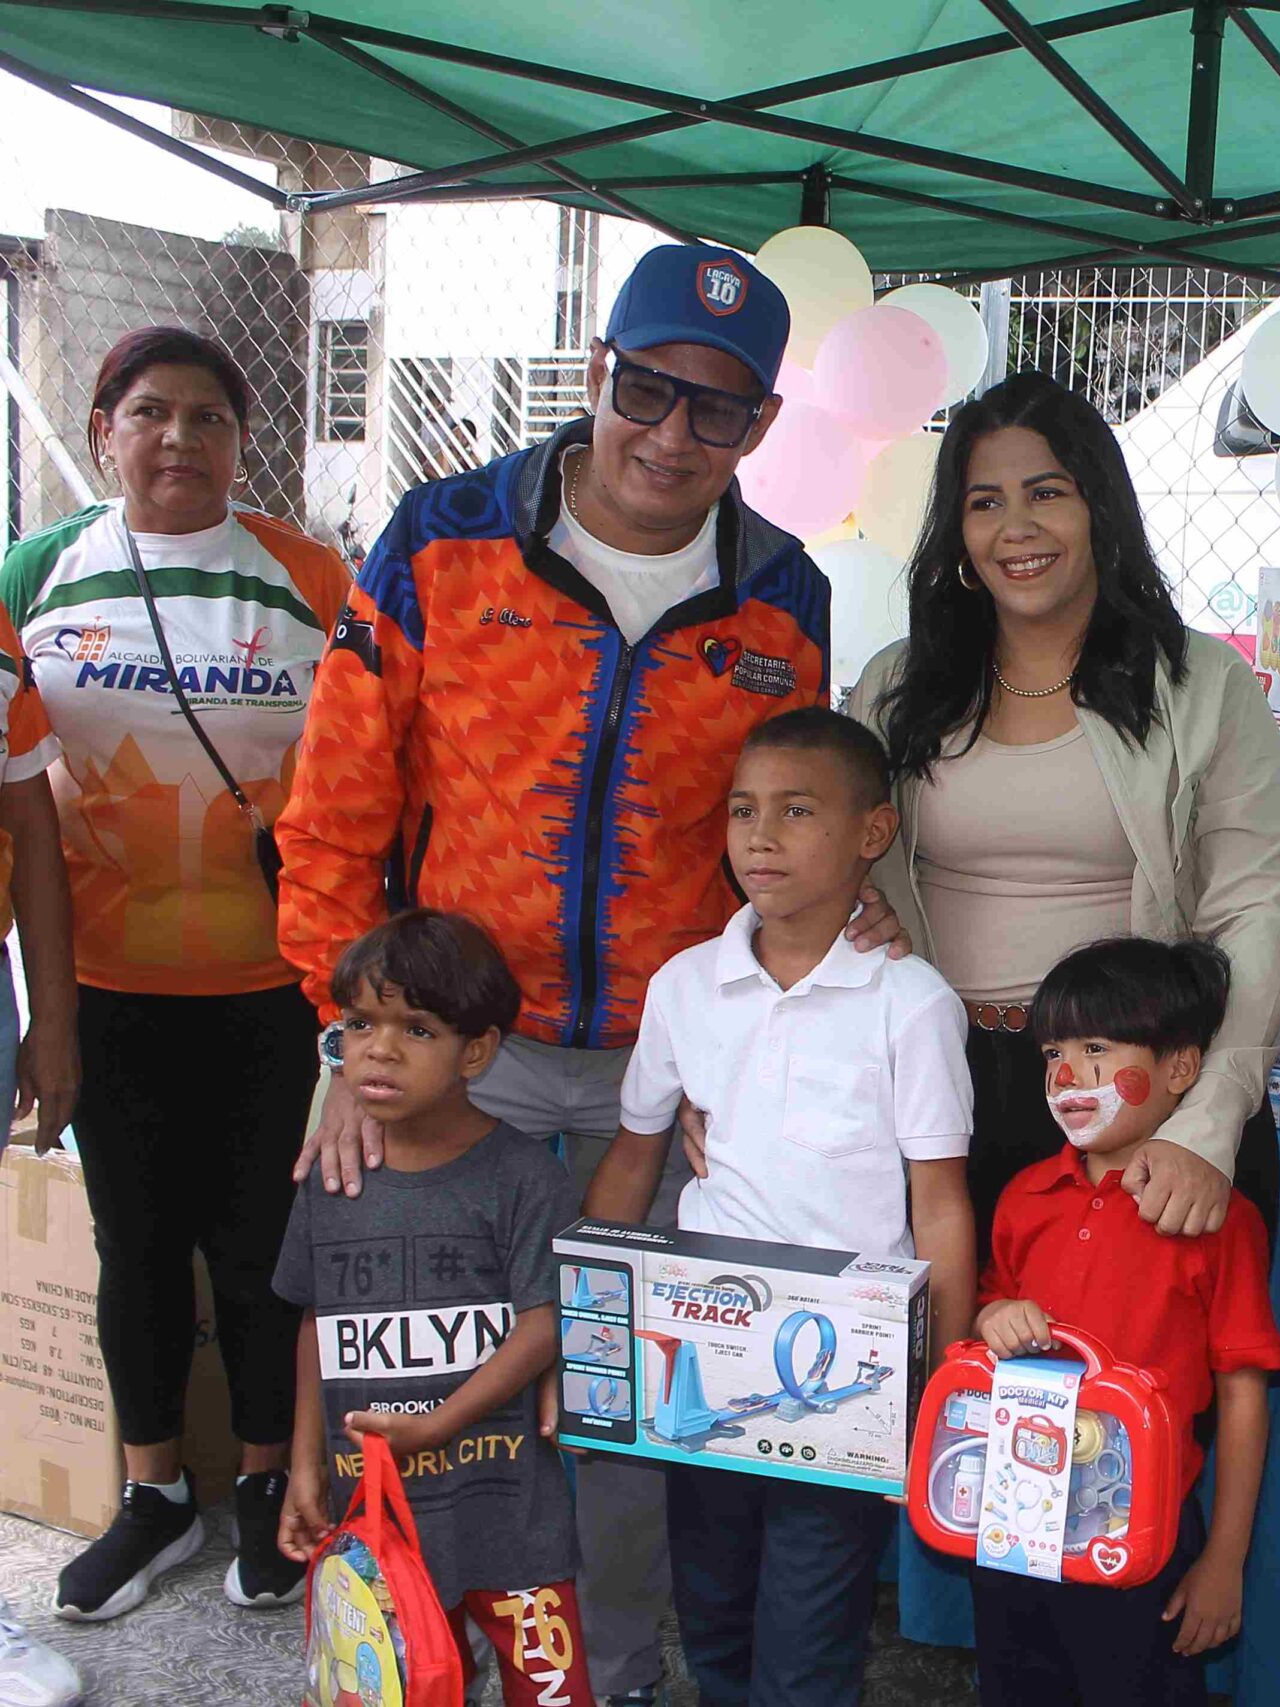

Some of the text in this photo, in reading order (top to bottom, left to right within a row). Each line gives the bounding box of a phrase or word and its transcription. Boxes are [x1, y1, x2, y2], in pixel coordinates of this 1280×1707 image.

[707, 268, 740, 288] LACAVA
[707, 279, 736, 305] 10
[257, 657, 274, 667] DE
[734, 665, 762, 681] POPULAR
[76, 662, 298, 696] MIRANDA
[36, 1280, 62, 1297] CHINA
[64, 1286, 73, 1299] IN
[652, 1282, 749, 1308] EJECTION
[671, 1300, 754, 1327] TRACK
[336, 1306, 510, 1370] BKLYN
[58, 1368, 104, 1391] QUANTITY:
[46, 1385, 105, 1412] DESCRIPTION:
[370, 1398, 444, 1414] BROOKL
[999, 1386, 1069, 1409] DOCTOR KIT
[84, 1416, 105, 1432] ITEM
[458, 1435, 524, 1465] CITY
[342, 1600, 367, 1637] TENT
[492, 1588, 573, 1673] 76
